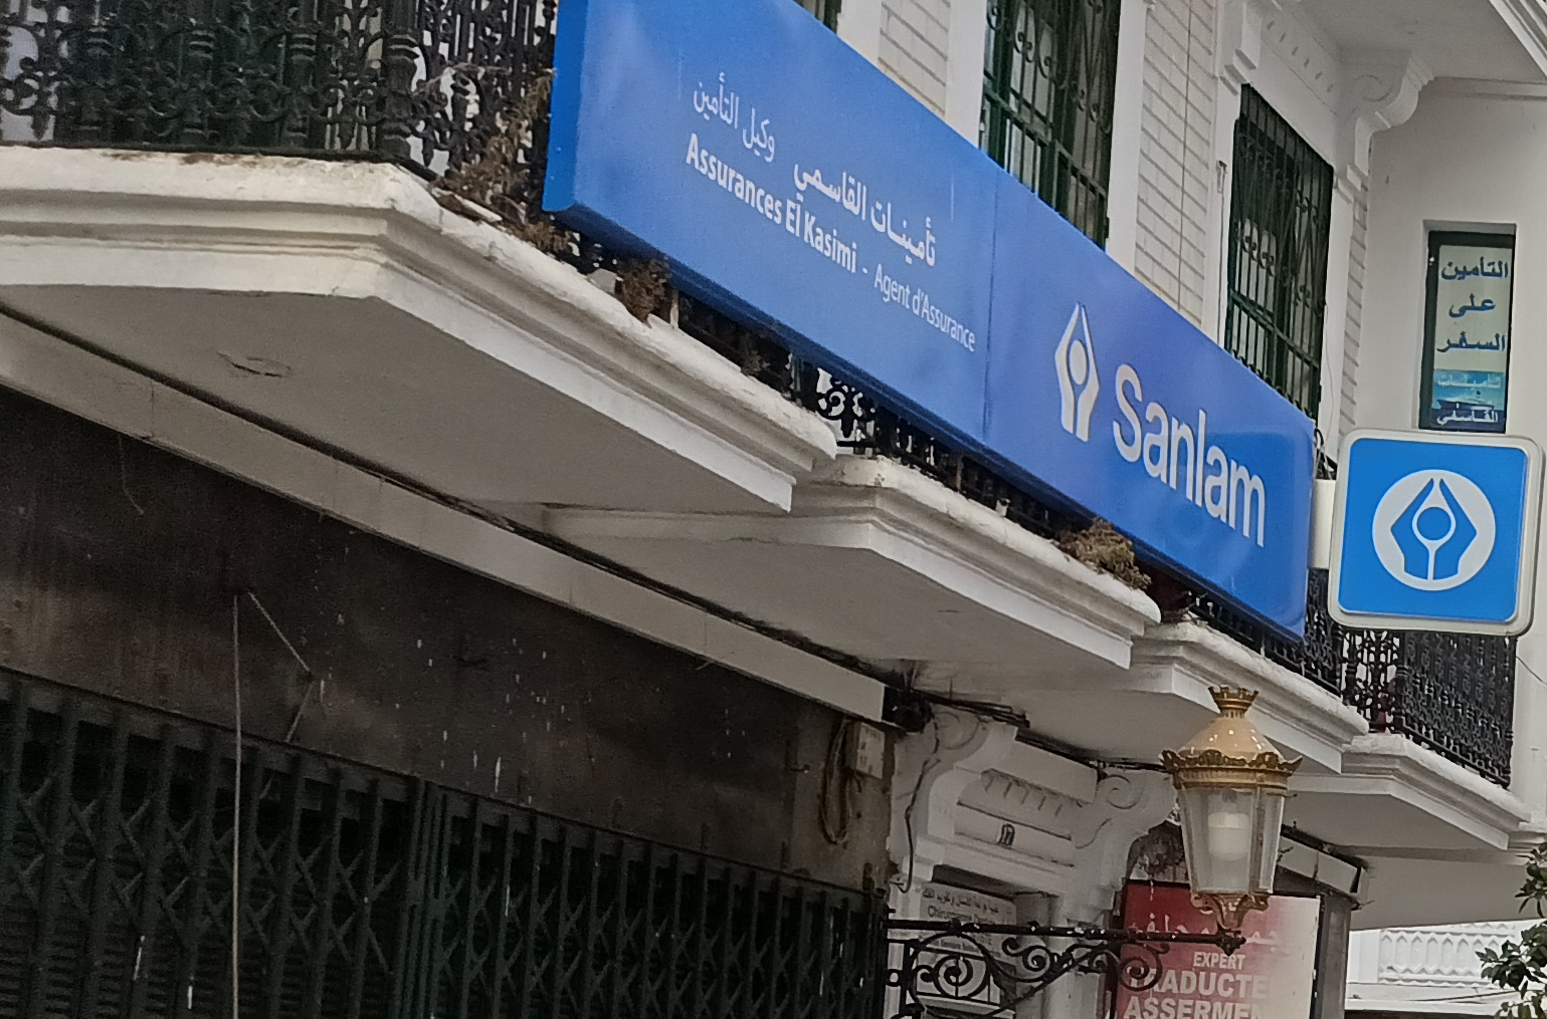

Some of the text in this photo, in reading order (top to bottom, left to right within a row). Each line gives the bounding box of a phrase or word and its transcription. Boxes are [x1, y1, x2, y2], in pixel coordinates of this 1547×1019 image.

[693, 71, 936, 266] تأمينات القاسمي وكيل التأمين
[686, 132, 783, 225] Assurances
[785, 198, 801, 237] El
[803, 210, 857, 274] Kasimi
[874, 263, 911, 308] Agent
[911, 288, 977, 353] d'Assurance
[1441, 256, 1509, 280] التأمين
[1449, 293, 1496, 317] على
[1437, 331, 1506, 352] السفر
[1112, 363, 1266, 548] Sanlam
[1193, 951, 1246, 970] EXPERT
